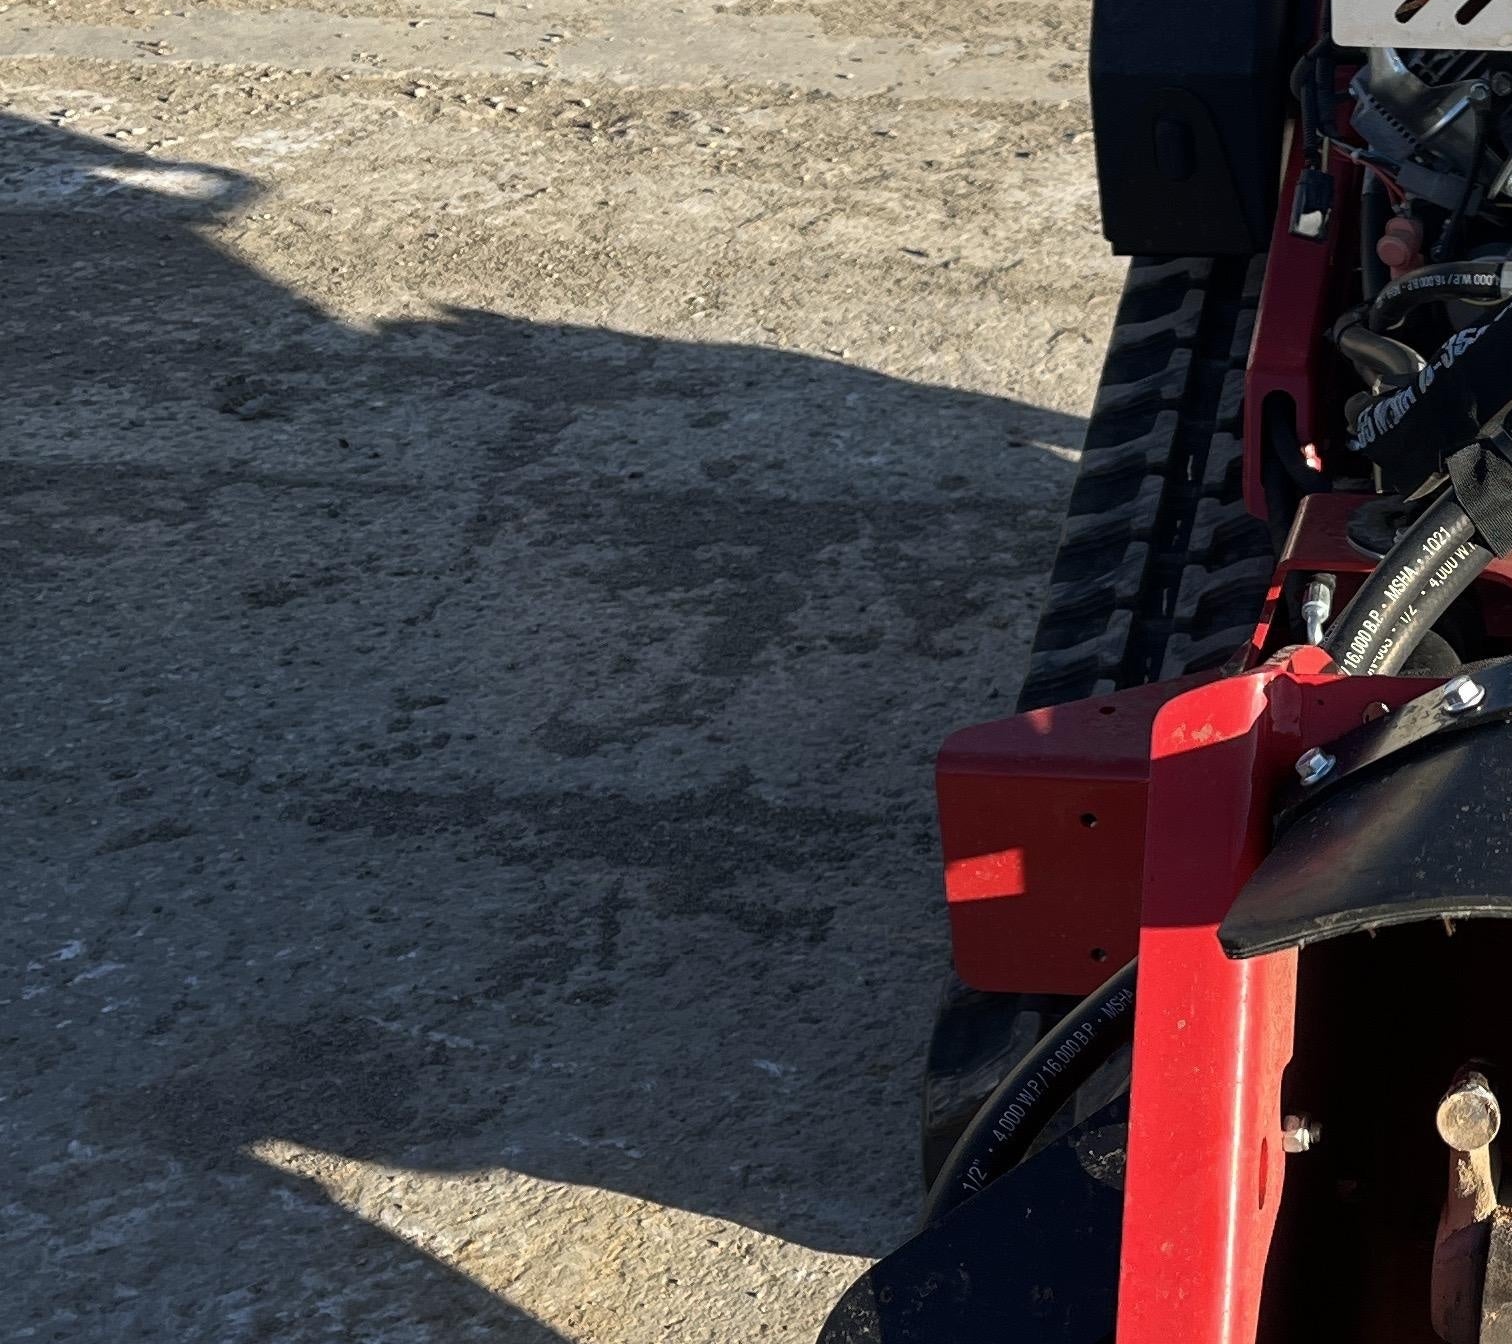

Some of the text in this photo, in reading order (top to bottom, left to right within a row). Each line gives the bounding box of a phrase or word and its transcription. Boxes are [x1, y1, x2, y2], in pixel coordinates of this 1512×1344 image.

[1344, 629, 1373, 669] 16,000
[1384, 565, 1418, 603] MSHA
[992, 1103, 1026, 1143] 4,000
[1042, 1039, 1081, 1077] 16,000
[1100, 988, 1134, 1019] MSHA
